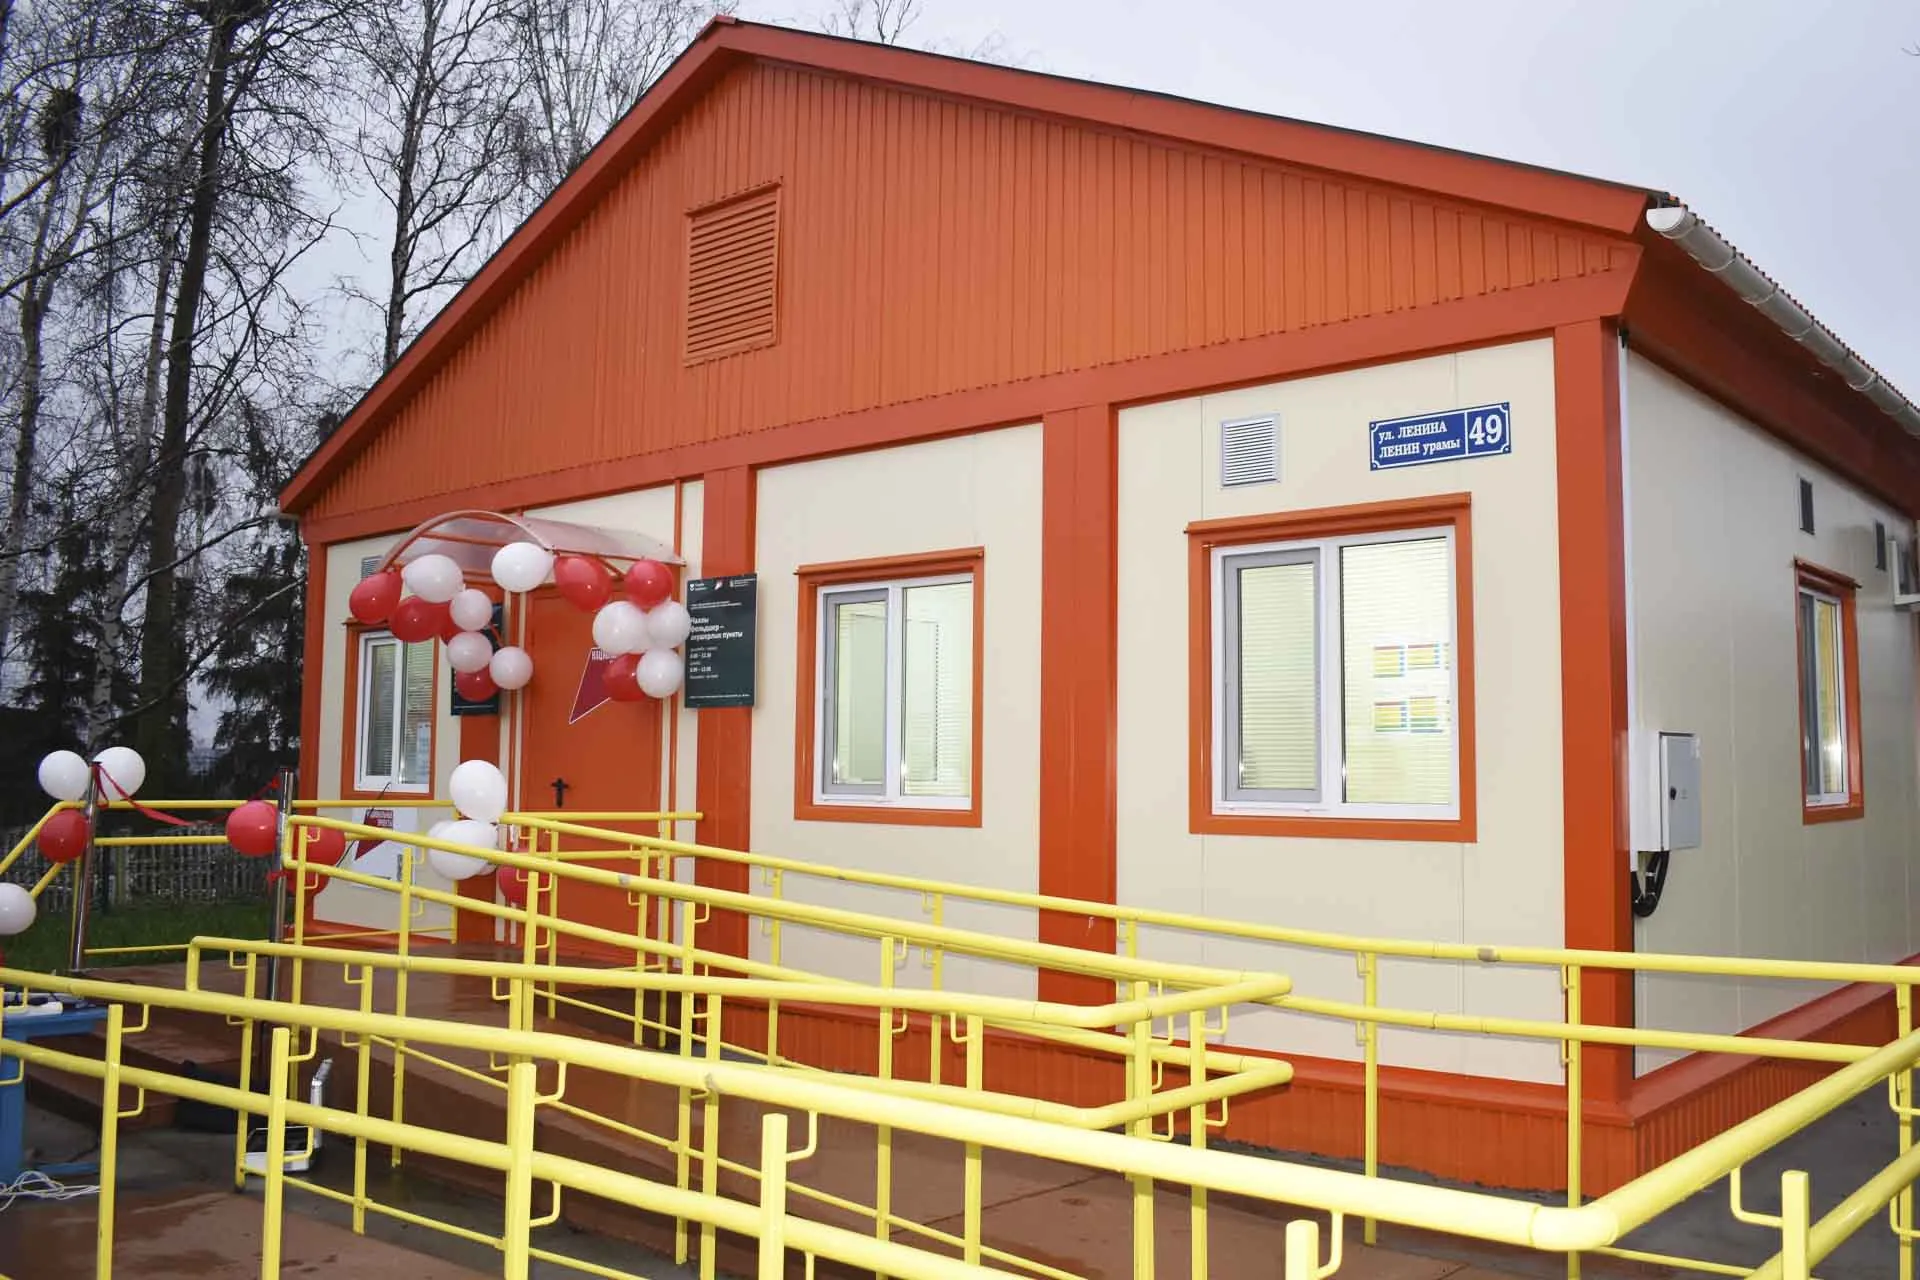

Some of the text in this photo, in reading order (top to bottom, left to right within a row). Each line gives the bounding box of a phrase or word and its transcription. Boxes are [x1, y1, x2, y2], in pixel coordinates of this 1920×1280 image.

[1378, 421, 1447, 444] ул. ЛЕНИНА
[1469, 414, 1502, 445] 49
[1379, 439, 1460, 458] ЛЕНИН урамы
